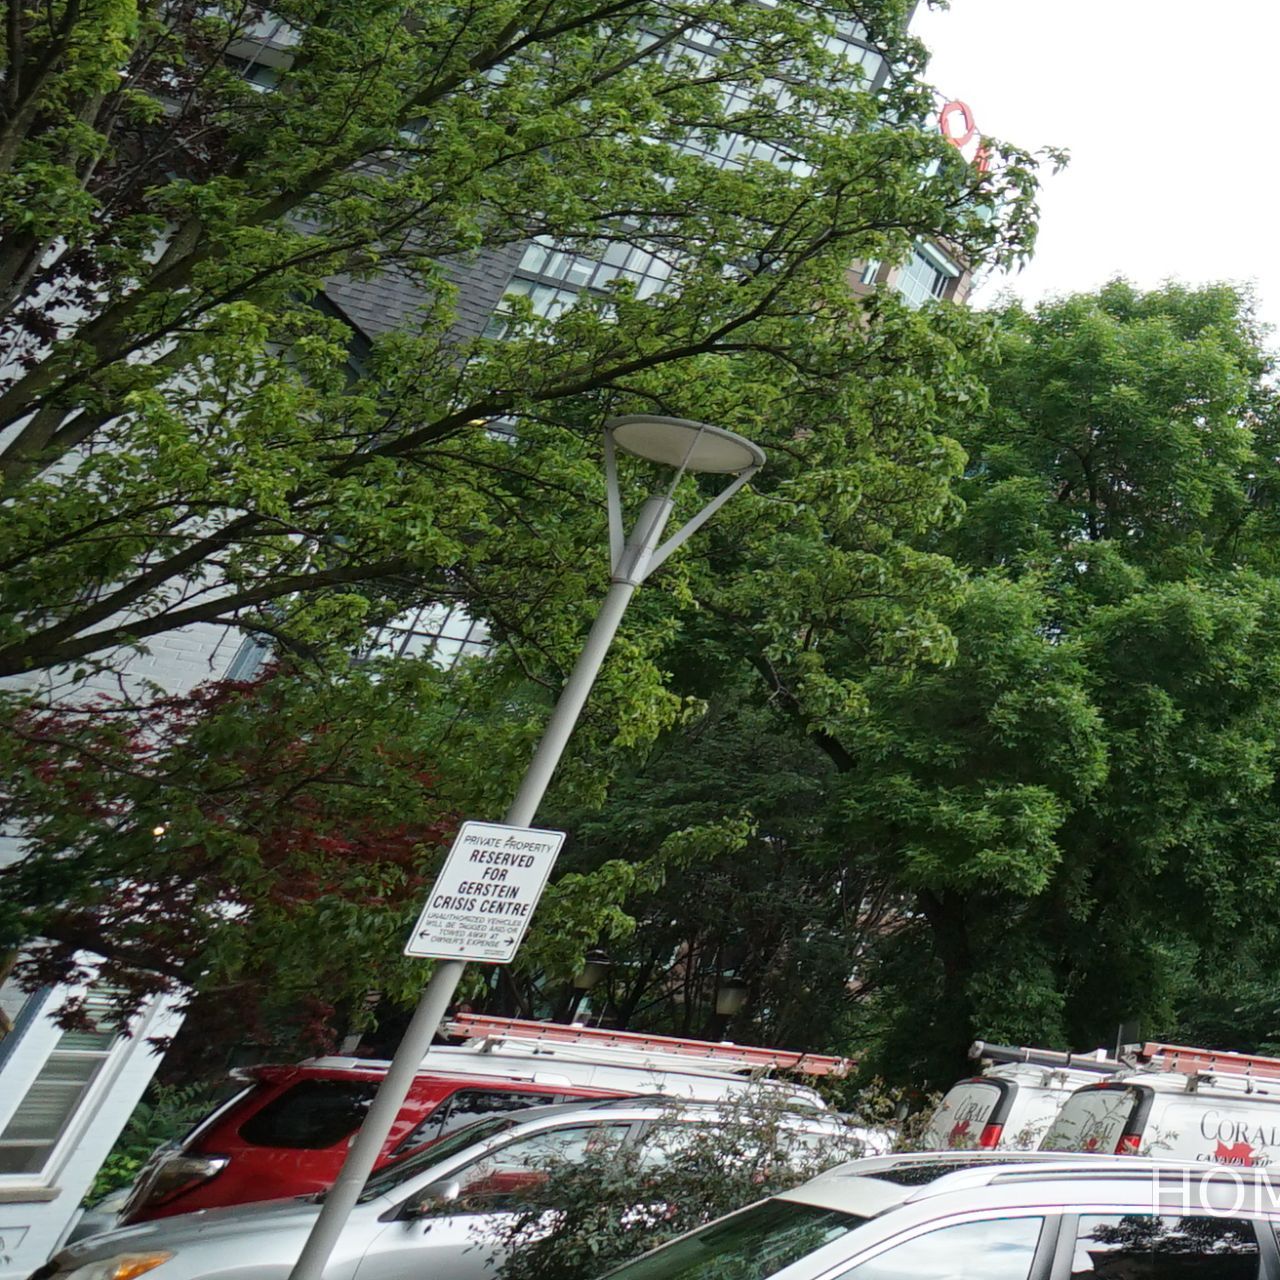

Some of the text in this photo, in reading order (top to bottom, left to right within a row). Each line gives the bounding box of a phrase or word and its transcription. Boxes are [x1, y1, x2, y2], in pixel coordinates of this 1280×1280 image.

[463, 835, 553, 853] PRIVATE PROPERTY
[469, 849, 535, 868] RESERVED
[482, 867, 509, 881] FOR
[458, 881, 520, 899] GERSTEIN
[432, 895, 530, 916] CRISIS CENTRE
[445, 921, 457, 929] BE
[466, 939, 500, 948] EXPENSE
